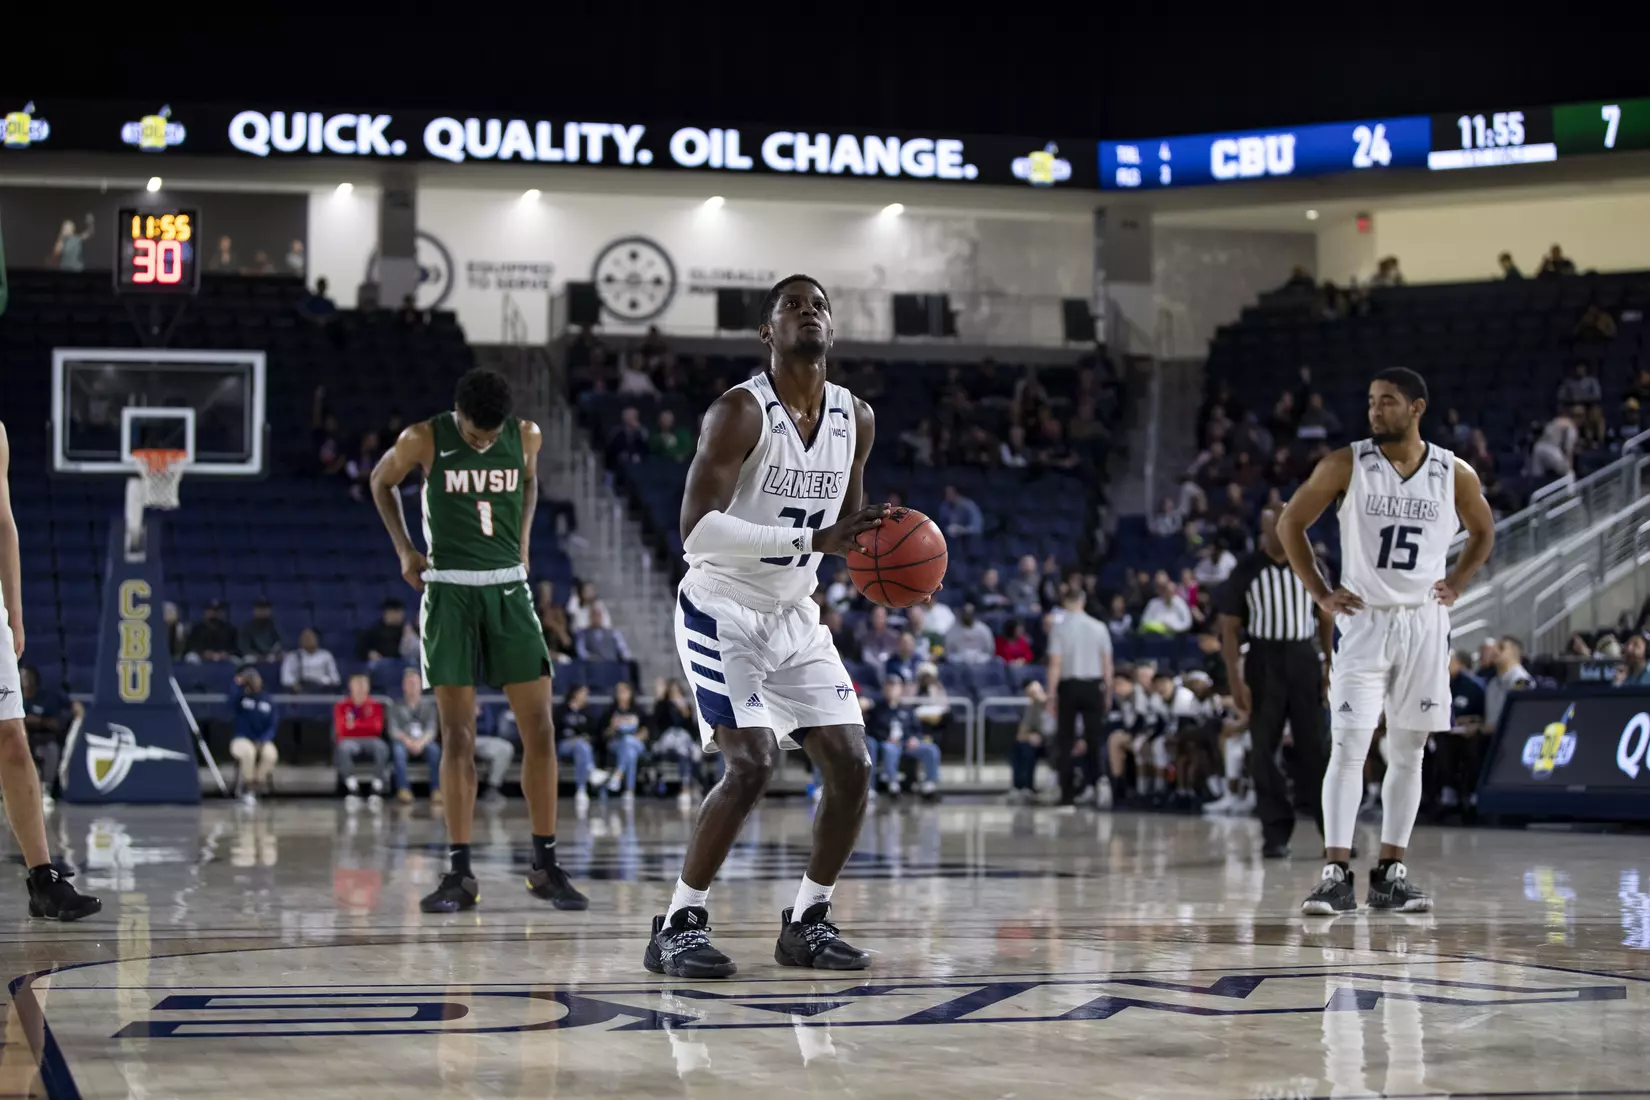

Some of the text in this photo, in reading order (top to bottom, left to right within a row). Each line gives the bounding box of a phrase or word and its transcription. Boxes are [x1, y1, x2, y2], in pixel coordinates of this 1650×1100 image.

[229, 110, 979, 180] QUICK. QUALITY. OIL CHANGE.
[1352, 123, 1392, 168] 24
[1457, 111, 1525, 149] 11:55
[1601, 104, 1621, 148] 7
[1210, 133, 1296, 179] CBU
[131, 213, 192, 241] 11:55
[131, 239, 183, 284] 30
[831, 428, 846, 438] WAC
[444, 469, 519, 493] MVSU
[762, 465, 844, 499] LANCERS
[477, 500, 494, 537] 1
[1366, 494, 1440, 522] LANCERS
[1376, 524, 1423, 571] 15
[117, 578, 152, 703] CBU
[1616, 711, 1650, 779] Q
